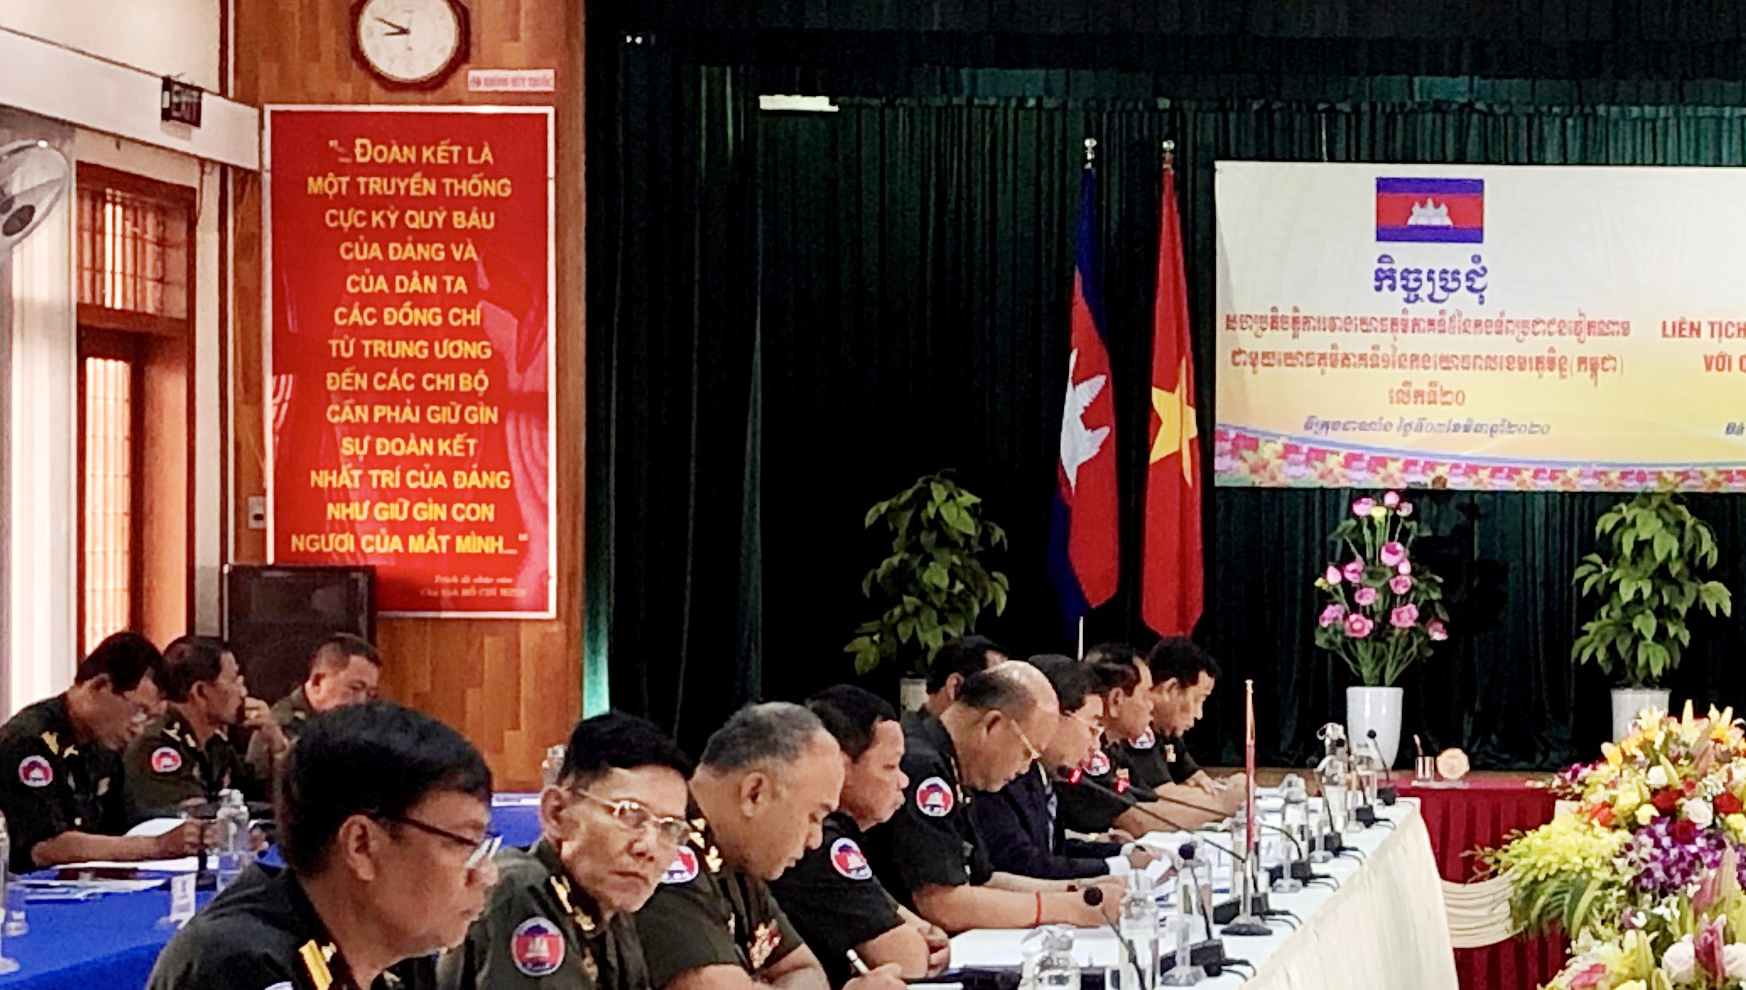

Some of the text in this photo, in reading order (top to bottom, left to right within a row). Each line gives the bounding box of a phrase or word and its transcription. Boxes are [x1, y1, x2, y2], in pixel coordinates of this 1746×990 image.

[307, 172, 350, 199] MỘT
[442, 172, 512, 197] THỐNG
[325, 207, 367, 232] CỰC
[339, 234, 383, 260] CỦA
[388, 235, 445, 261] ĐẢNG
[346, 267, 468, 294] CỦA DÂN TA
[334, 301, 377, 326] CÁC
[1662, 316, 1701, 338] LIÊN
[361, 340, 428, 358] TRUNG
[434, 338, 492, 358] ƯƠNG
[1704, 351, 1732, 373] VỚI
[326, 366, 489, 397] ĐẾN CÁC CHI BỘ
[375, 432, 434, 456] ĐOÀN
[405, 463, 447, 488] CỦA
[326, 500, 370, 521] NHƯ
[451, 503, 495, 521] CON
[361, 528, 404, 553] CỦA
